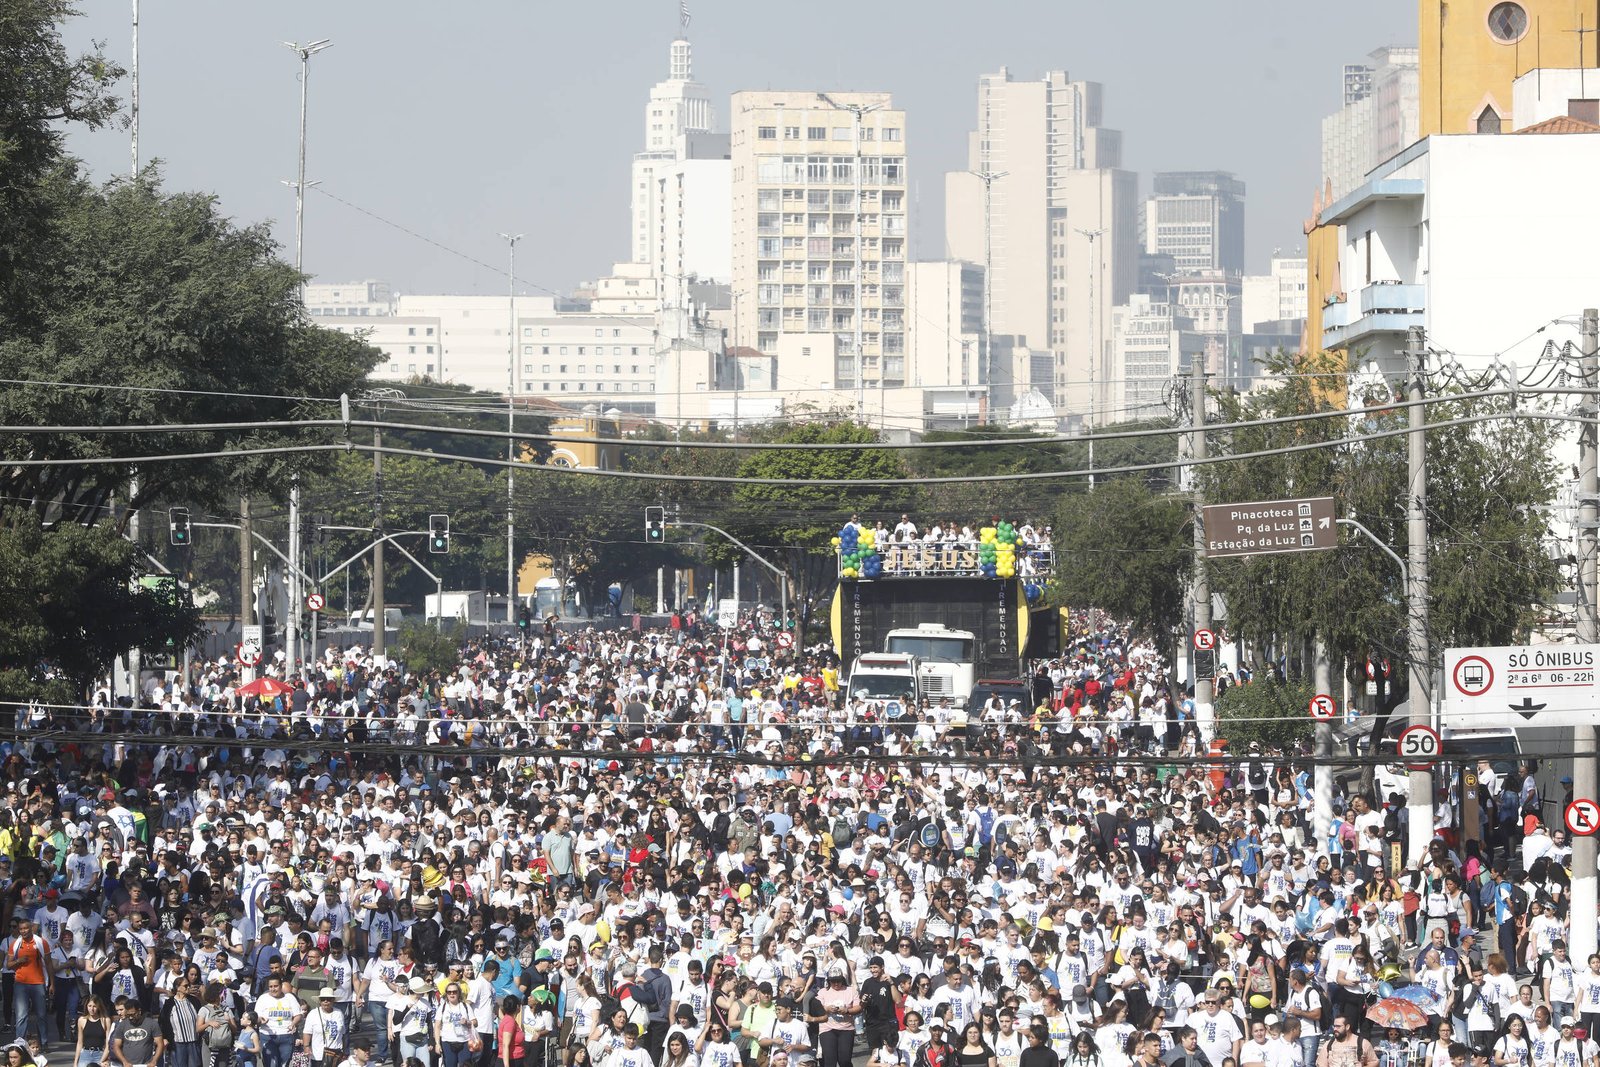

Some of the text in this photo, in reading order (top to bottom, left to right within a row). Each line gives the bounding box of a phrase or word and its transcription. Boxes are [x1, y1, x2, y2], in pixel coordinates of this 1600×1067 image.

[1231, 509, 1294, 520] Pinacoteca
[1238, 522, 1294, 534] Pq. da Luz
[1210, 536, 1296, 550] Estação da Luz
[888, 550, 976, 568] JESUS
[1200, 634, 1208, 646] E
[1508, 648, 1593, 667] SÓ ÔNIBUS
[1550, 674, 1564, 682] 06
[1574, 672, 1594, 681] 22h
[1318, 701, 1327, 715] E
[1406, 735, 1434, 754] 50
[1577, 807, 1590, 827] E
[1592, 986, 1600, 1004] JESUS
[692, 995, 701, 1014] JESUS
[1208, 1022, 1216, 1042] JESUS
[1534, 1041, 1545, 1060] JESUS
